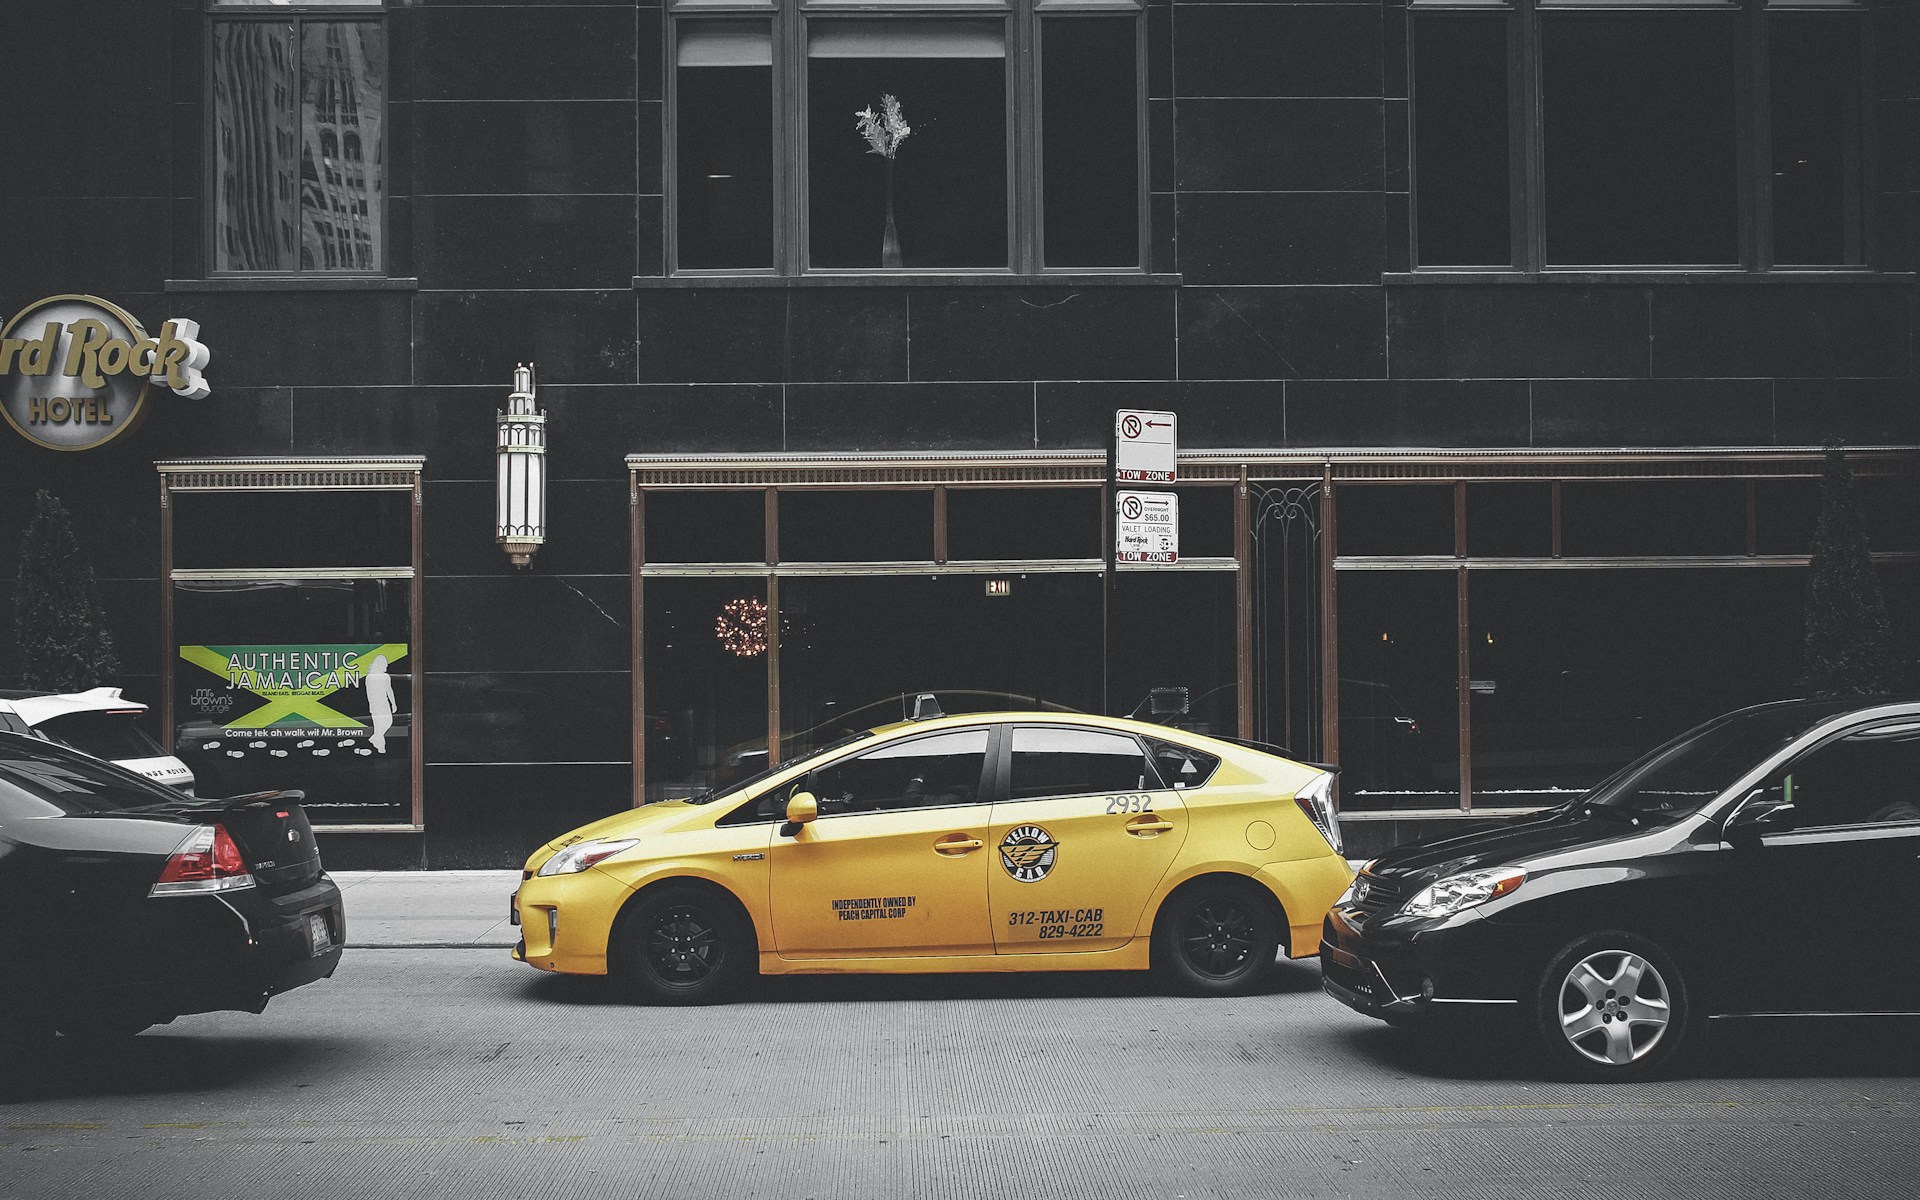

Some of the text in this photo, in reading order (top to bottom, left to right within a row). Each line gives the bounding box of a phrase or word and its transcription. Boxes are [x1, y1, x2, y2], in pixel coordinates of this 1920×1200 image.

[63, 318, 191, 389] Rock
[28, 397, 113, 424] HOTEL
[1120, 470, 1171, 481] TOW ZONE
[1144, 513, 1170, 522] $65.00
[1121, 525, 1171, 534] VALET LOADING
[1121, 551, 1172, 562] TOW ZONE
[227, 652, 359, 670] AUTHENTIC
[225, 672, 360, 689] JAMAICAN
[190, 694, 233, 706] brown's
[225, 728, 364, 737] Come tek ah walk wit Mr. Brown
[1105, 794, 1153, 815] 2932
[1005, 826, 1050, 845] YELLOW
[1015, 866, 1045, 879] CAB
[831, 896, 916, 911] INDEPENDENTLY OWNED BY
[838, 908, 906, 921] PEACH CAPITAL CORP
[1009, 909, 1103, 926] 312-TAXI-CAB
[1039, 923, 1104, 939] 829-4222
